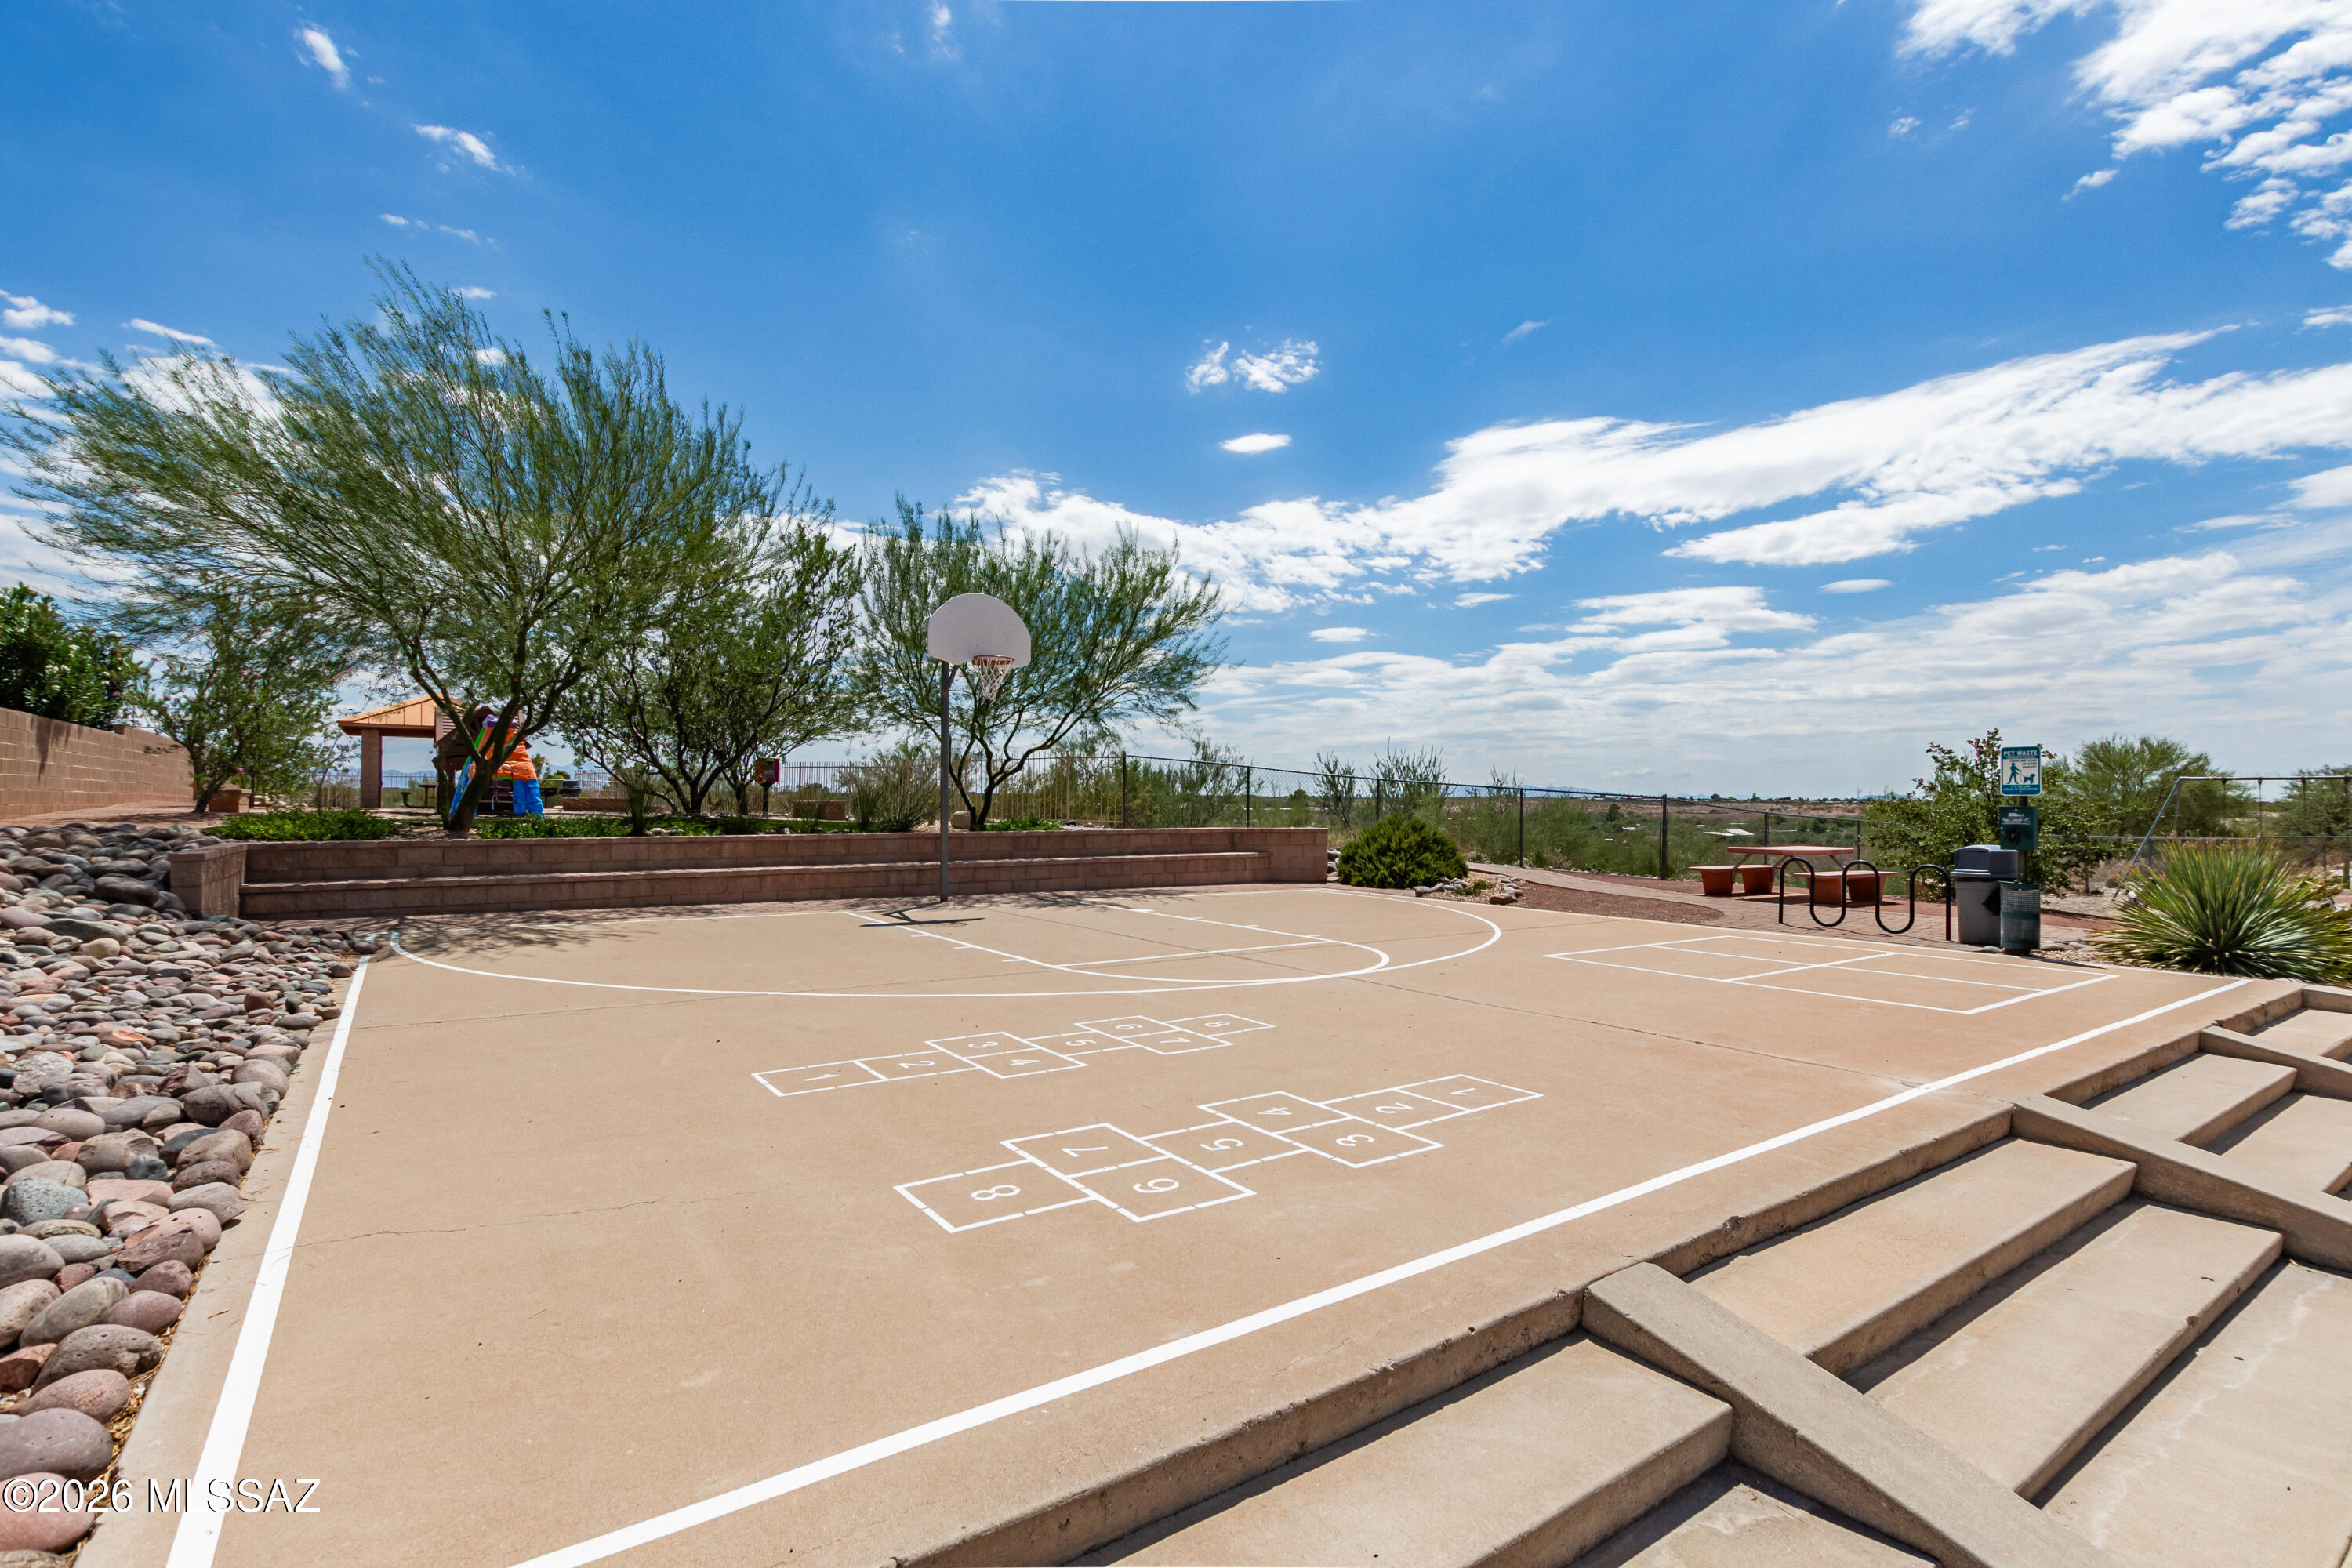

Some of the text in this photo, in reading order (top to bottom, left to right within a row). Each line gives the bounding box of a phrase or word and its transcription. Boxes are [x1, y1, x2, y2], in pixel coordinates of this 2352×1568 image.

[967, 1040, 1000, 1049] 3
[898, 1059, 935, 1069] 2
[803, 1073, 840, 1082] 1
[1449, 1087, 1477, 1097] 1
[1256, 1106, 1293, 1116] 4
[1374, 1102, 1414, 1116] 2
[1198, 1138, 1244, 1152] 5
[1335, 1134, 1376, 1148] 3
[1060, 1145, 1109, 1159] 7
[970, 1183, 1022, 1202] 8
[1132, 1177, 1180, 1194] 6
